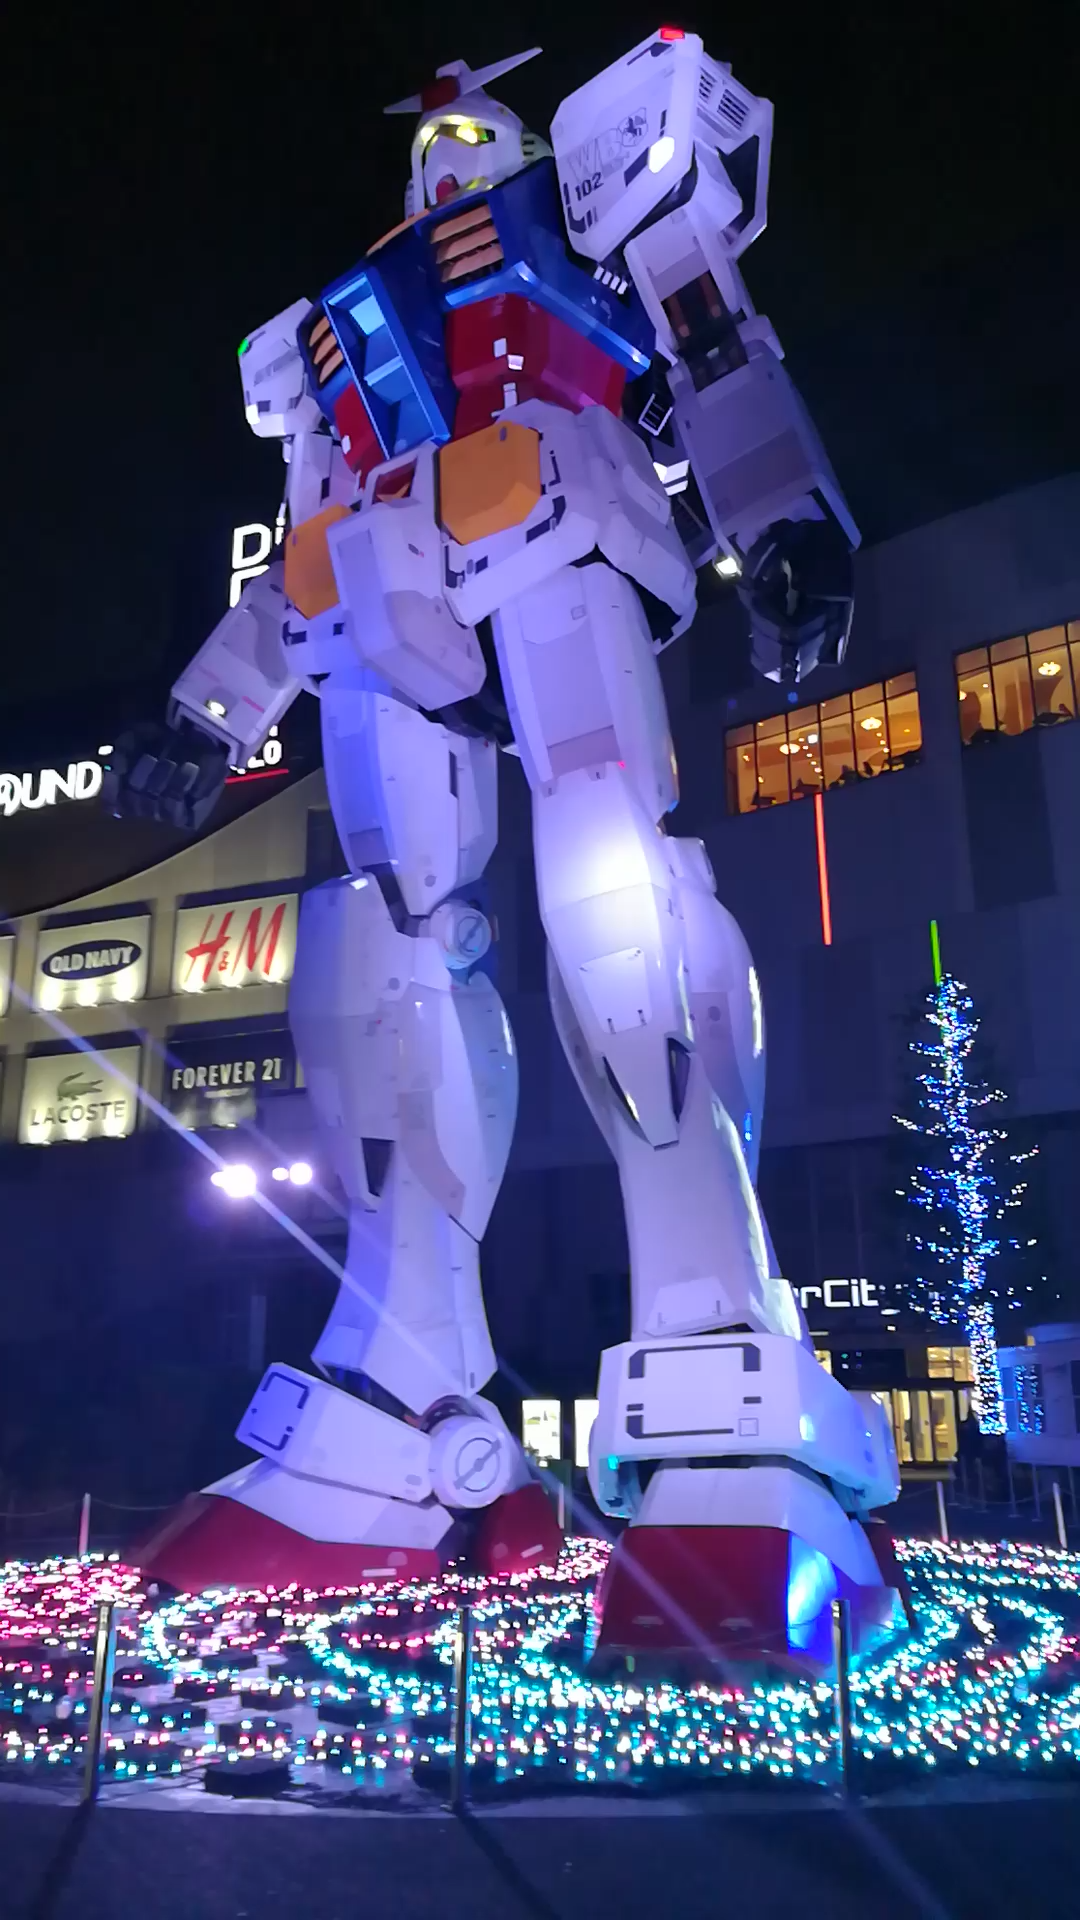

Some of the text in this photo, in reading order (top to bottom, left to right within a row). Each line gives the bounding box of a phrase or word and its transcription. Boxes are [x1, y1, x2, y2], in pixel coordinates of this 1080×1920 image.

[575, 171, 604, 201] 102
[185, 902, 287, 984] H&M
[49, 946, 134, 974] OLD NAVY
[172, 1057, 283, 1090] FOREVER 21
[30, 1100, 126, 1126] LACOSTE
[793, 1278, 880, 1309] rCit
